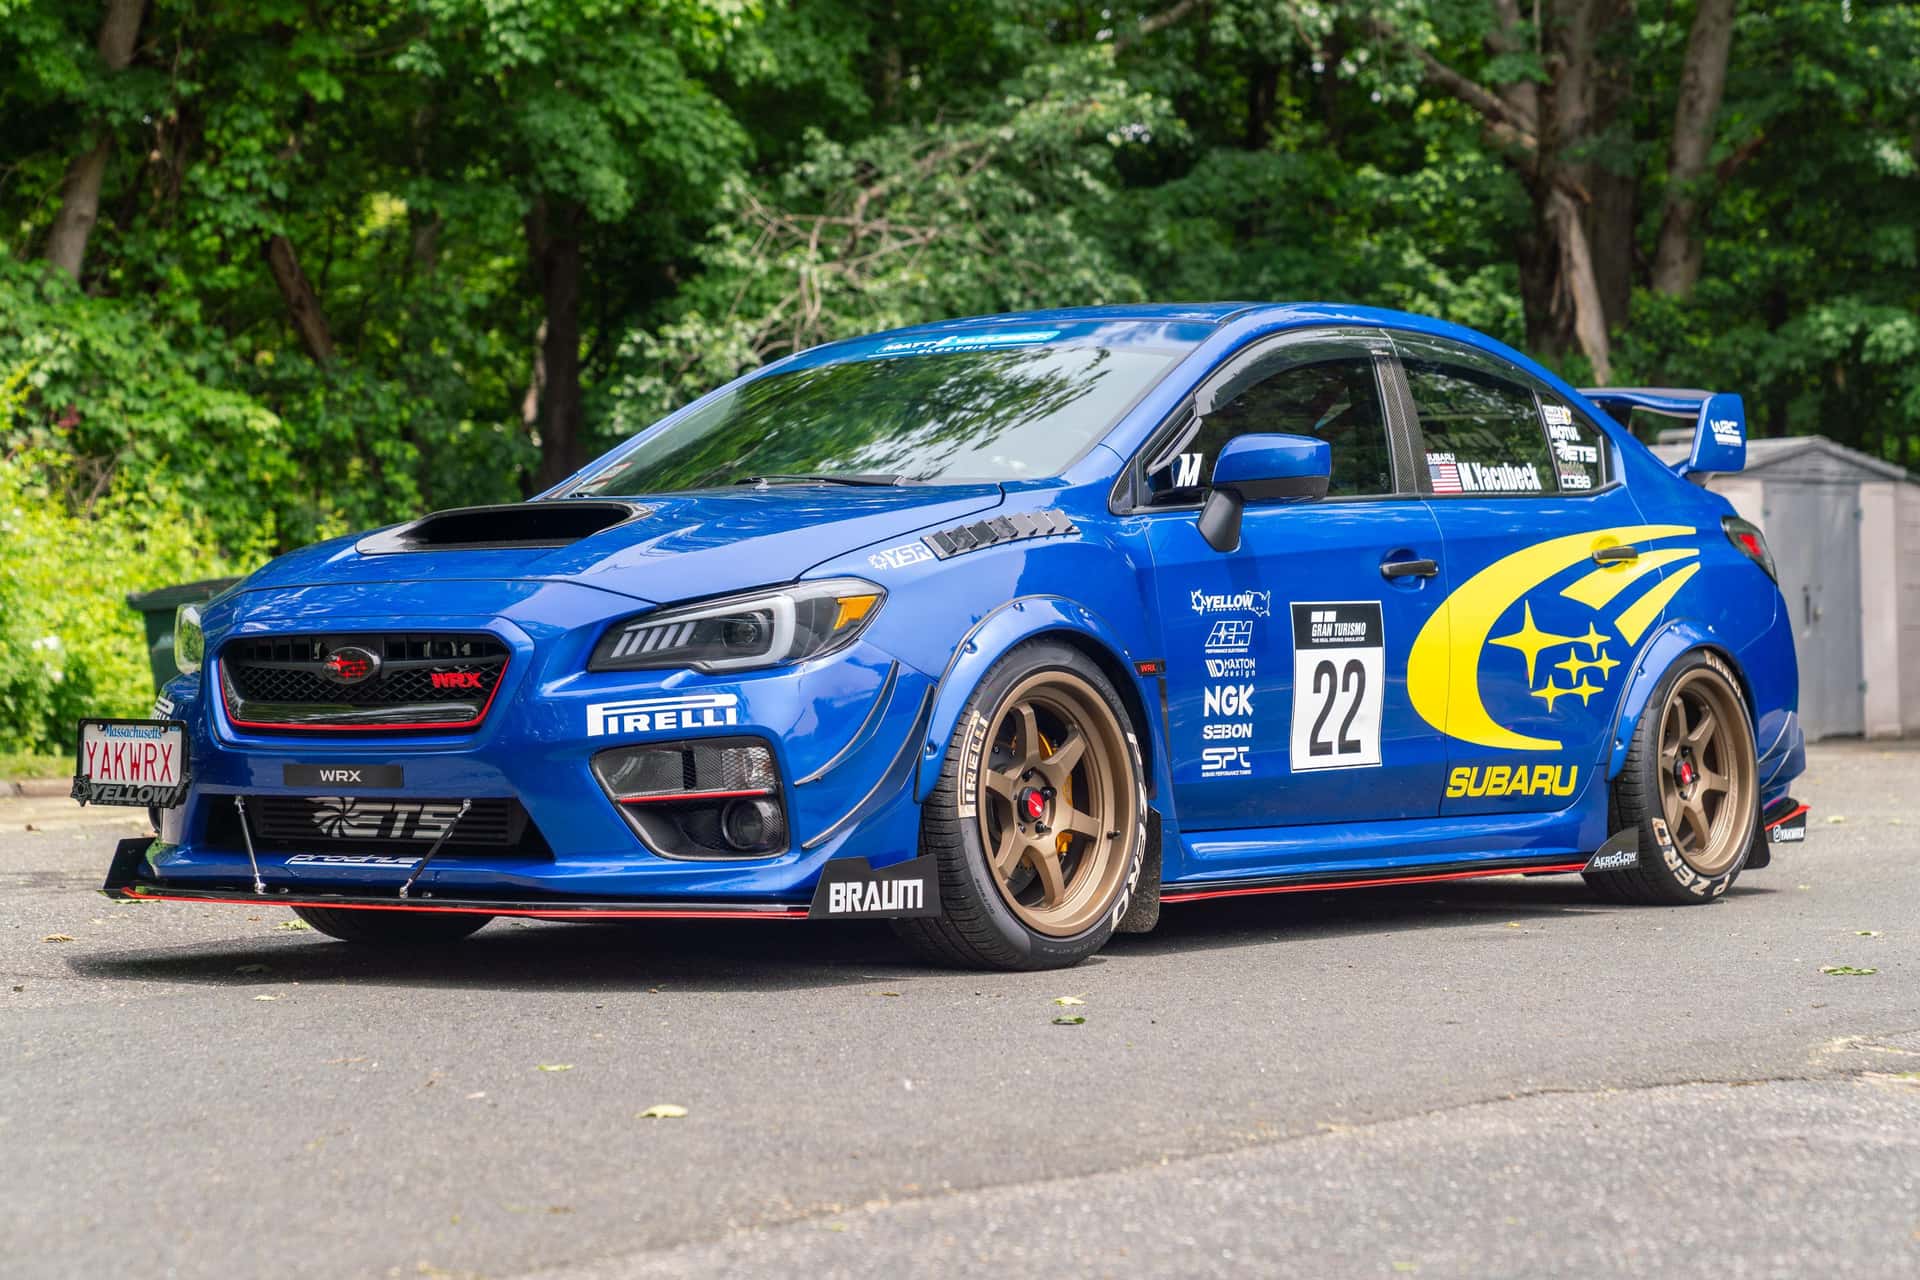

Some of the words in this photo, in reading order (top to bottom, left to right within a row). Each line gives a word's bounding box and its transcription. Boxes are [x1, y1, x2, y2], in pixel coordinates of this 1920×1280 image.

[1176, 453, 1203, 487] M
[1457, 462, 1542, 490] M.Yacubeck
[884, 543, 935, 568] YSR
[1205, 594, 1253, 608] YELLOW
[1311, 624, 1333, 637] GRAN
[1335, 622, 1366, 636] TURISMO
[1224, 658, 1255, 669] MAXTON
[1224, 670, 1255, 678] design
[431, 672, 482, 688] WRX
[1203, 683, 1255, 717] NGK
[1309, 659, 1366, 757] 22
[587, 693, 738, 736] PIRELLI
[104, 724, 162, 739] Massachusetts
[1203, 723, 1253, 739] SEBON
[85, 741, 173, 782] YAKWRX
[958, 709, 989, 818] PIRELLI
[1201, 746, 1251, 769] SPT
[320, 769, 361, 782] WRX
[1446, 765, 1578, 797] SUBARU
[90, 784, 174, 803] YELLOW
[340, 802, 462, 838] ETS
[1652, 817, 1711, 896] ZERO
[829, 879, 923, 913] BRAUM
[1713, 873, 1730, 896] P
